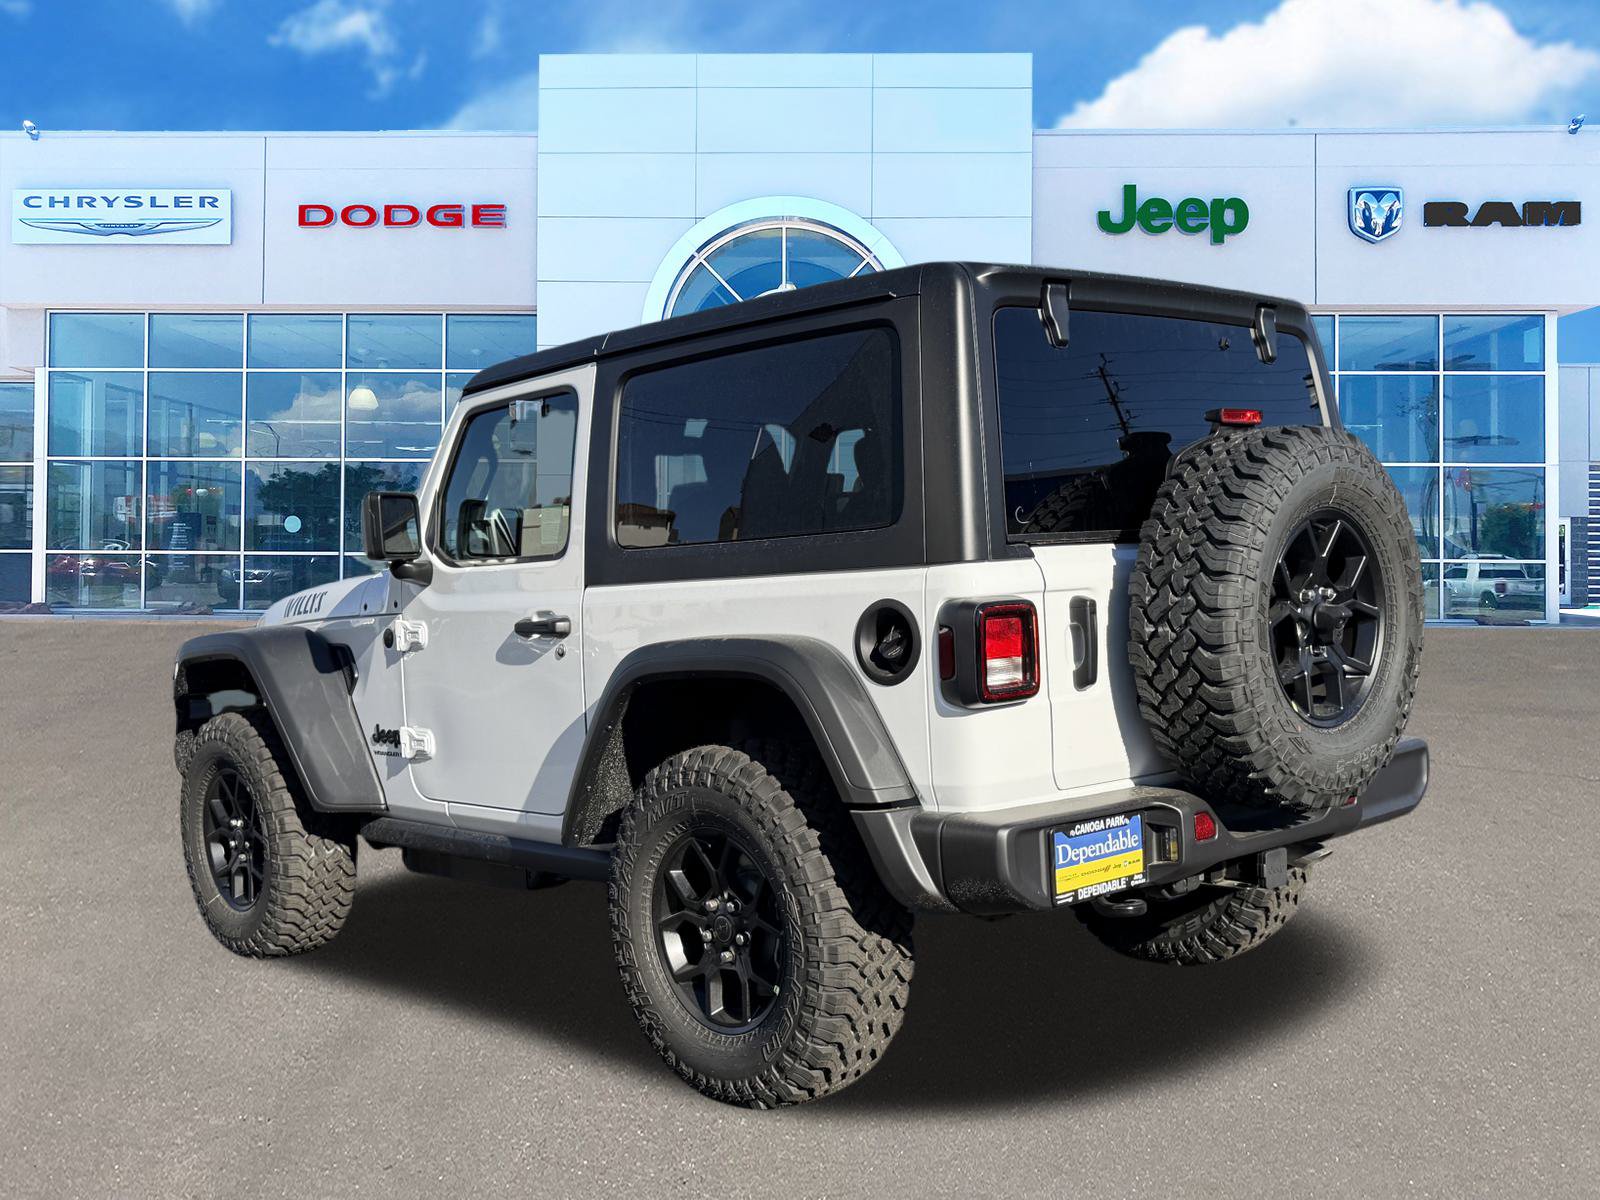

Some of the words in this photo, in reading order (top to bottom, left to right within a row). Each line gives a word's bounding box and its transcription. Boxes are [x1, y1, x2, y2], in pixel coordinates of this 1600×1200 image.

[23, 195, 219, 208] CHRYSLER
[298, 204, 506, 228] DODGE
[1097, 184, 1249, 245] Jeep
[1424, 202, 1581, 227] RAM
[283, 591, 328, 618] WILLYS
[372, 724, 401, 748] Jeep
[1075, 819, 1105, 835] CANOGA
[1106, 815, 1125, 828] PARK
[1056, 828, 1139, 865] Dependable
[1078, 879, 1126, 900] DEPENDABLE
